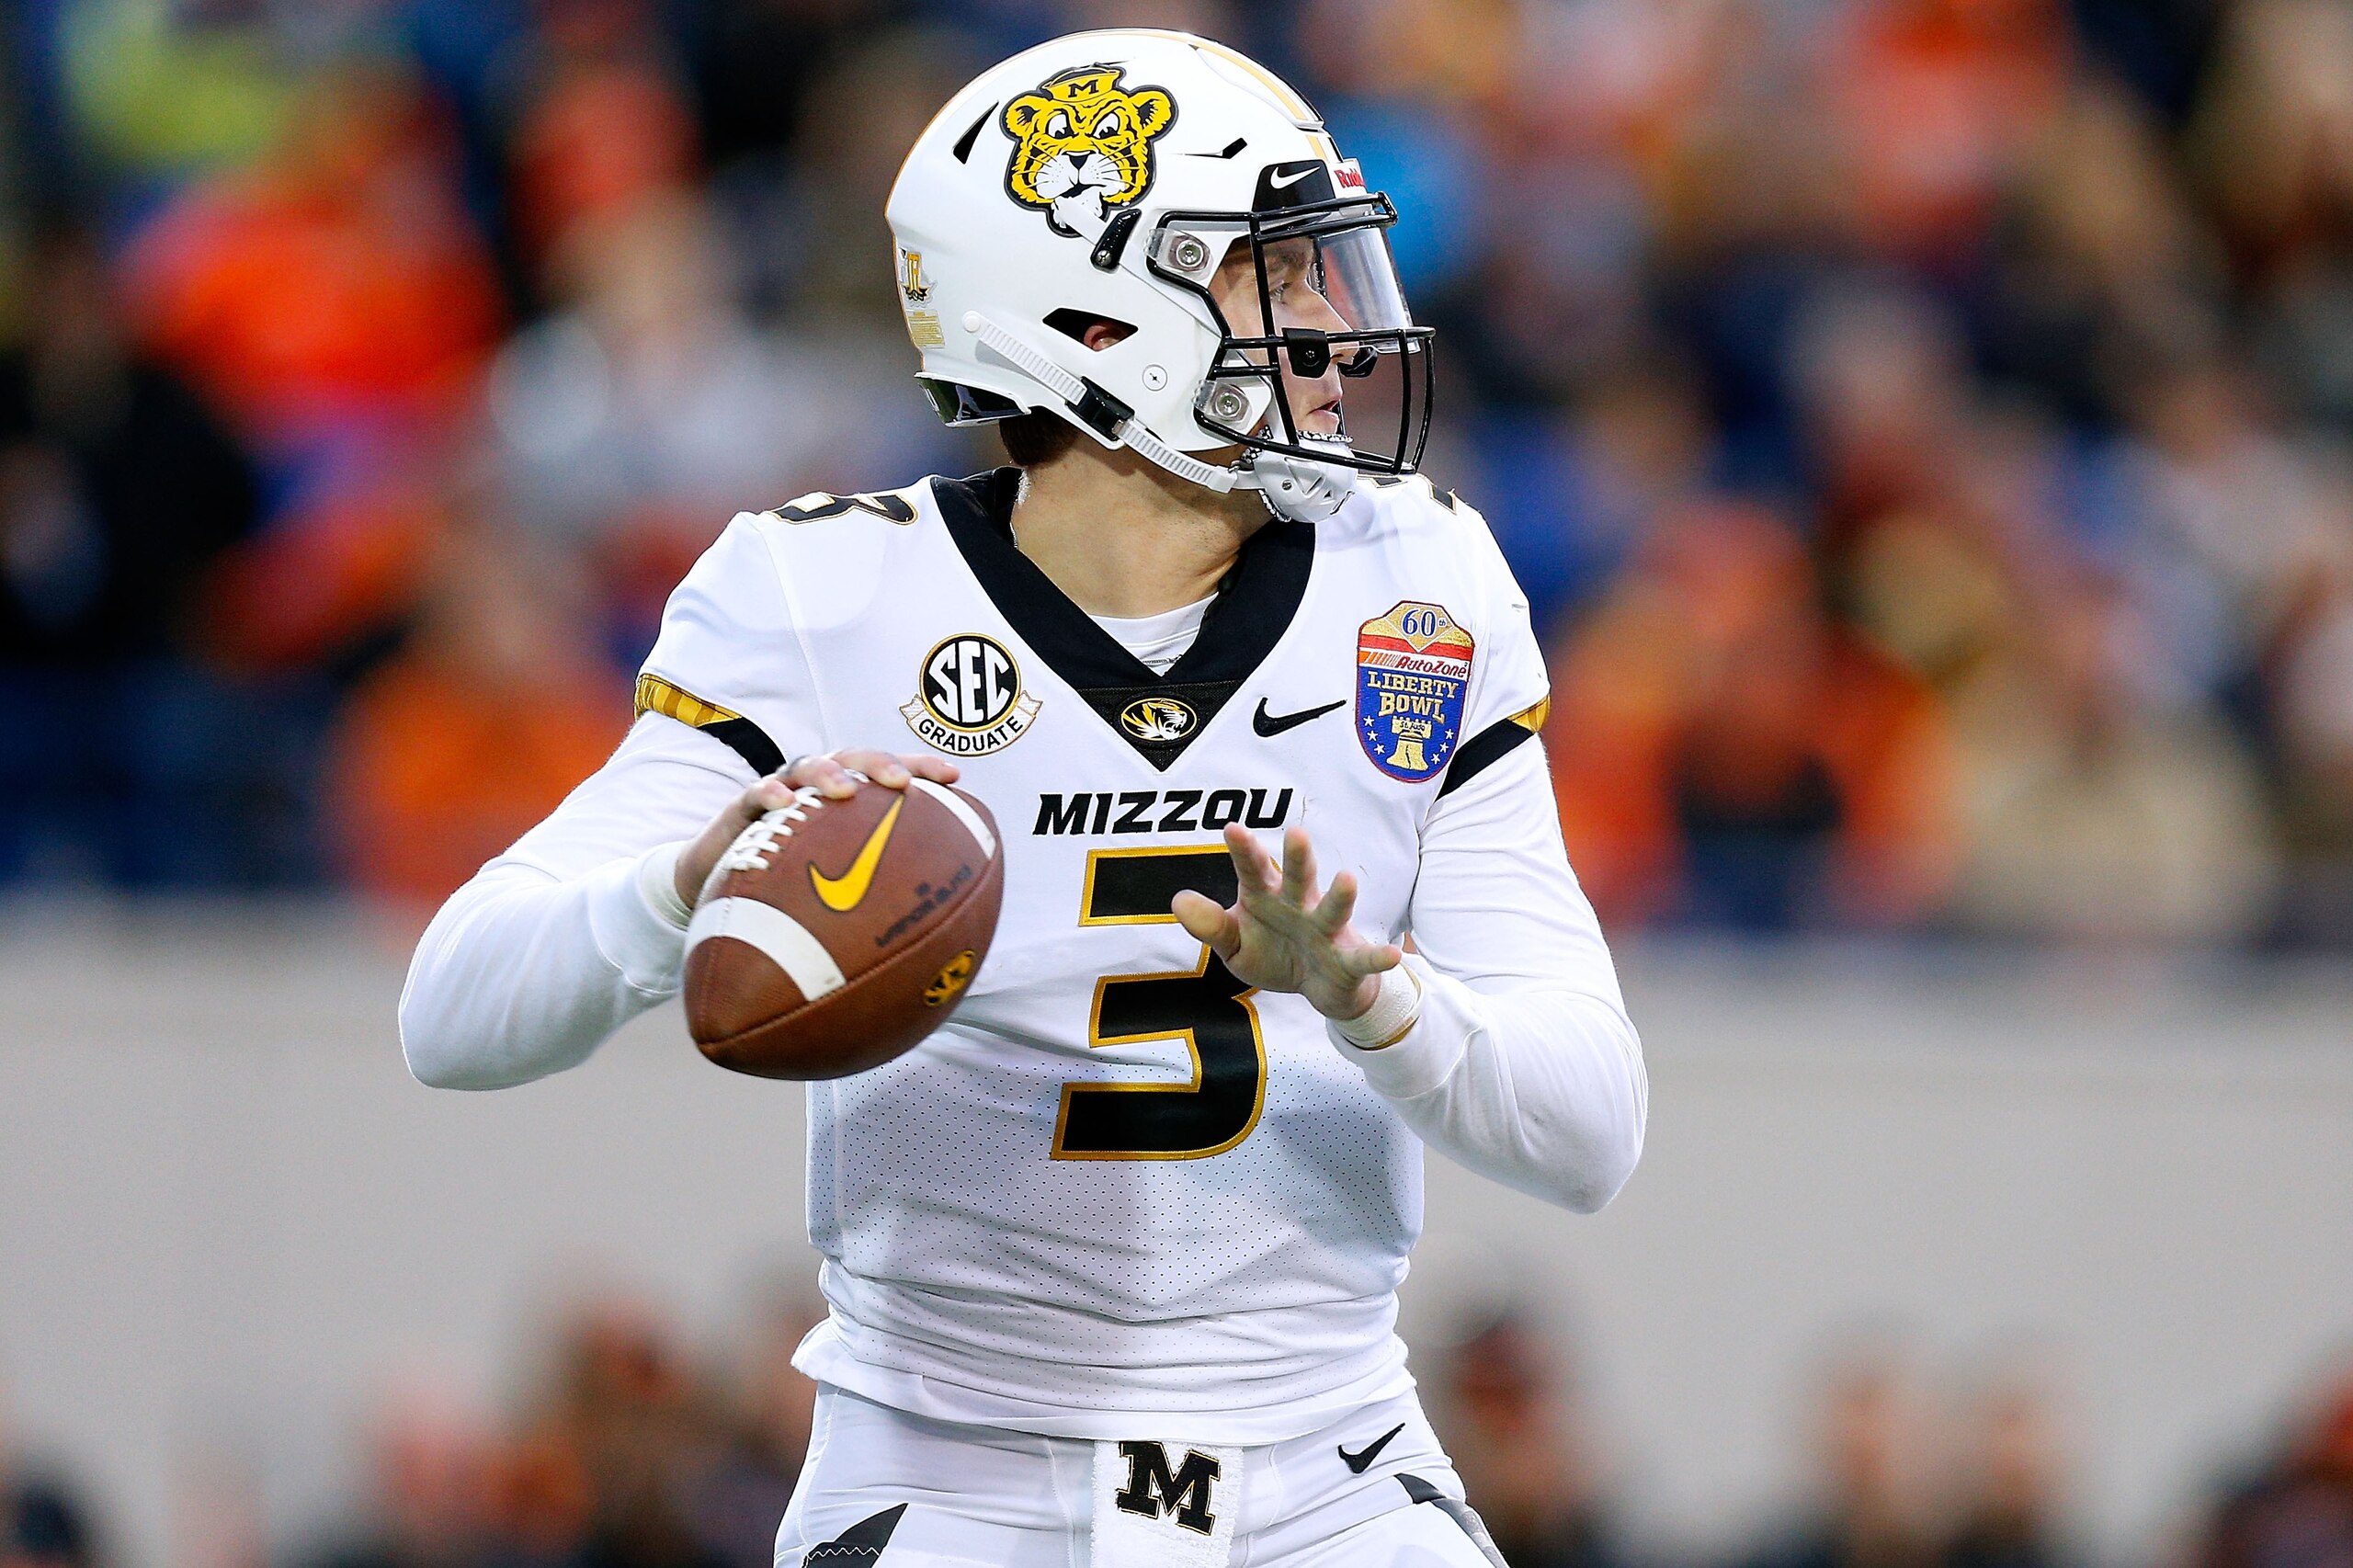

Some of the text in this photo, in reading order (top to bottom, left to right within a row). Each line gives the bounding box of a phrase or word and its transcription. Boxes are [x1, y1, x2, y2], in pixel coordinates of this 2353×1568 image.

[1068, 79, 1099, 98] M
[928, 641, 1011, 723] SEC
[1396, 655, 1467, 678] AutoZone
[1367, 671, 1459, 699] LIBERTY
[1378, 691, 1446, 725] BOWL
[918, 716, 1023, 752] GRADUATE
[1032, 788, 1293, 835] MIZZOU
[1050, 844, 1282, 1161] 3
[1115, 1440, 1222, 1536] M
